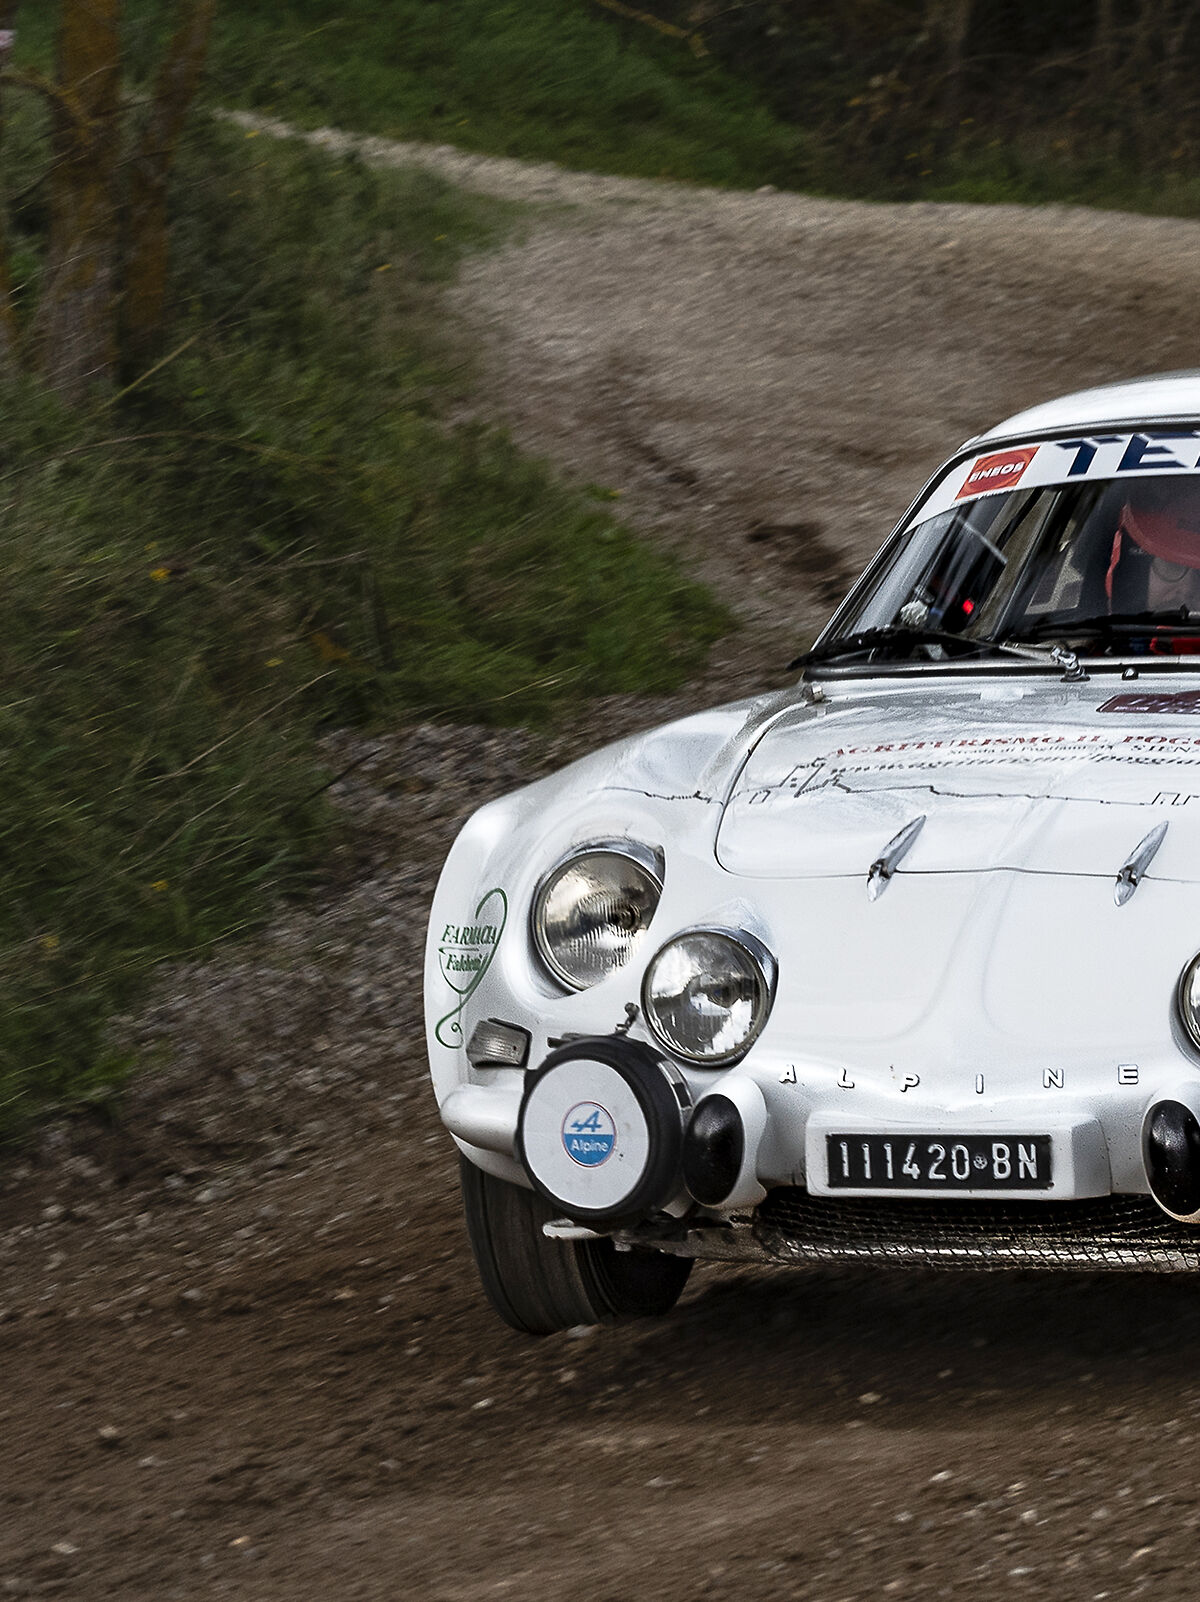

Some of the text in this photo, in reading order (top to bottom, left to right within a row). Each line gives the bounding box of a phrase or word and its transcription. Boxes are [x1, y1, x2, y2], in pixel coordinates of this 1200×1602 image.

[967, 461, 1025, 484] ENEOS
[441, 924, 497, 945] FARMACIA
[778, 1063, 1139, 1094] ALPINE
[571, 1138, 609, 1154] Alpine
[839, 1140, 1038, 1180] 111420 BN
